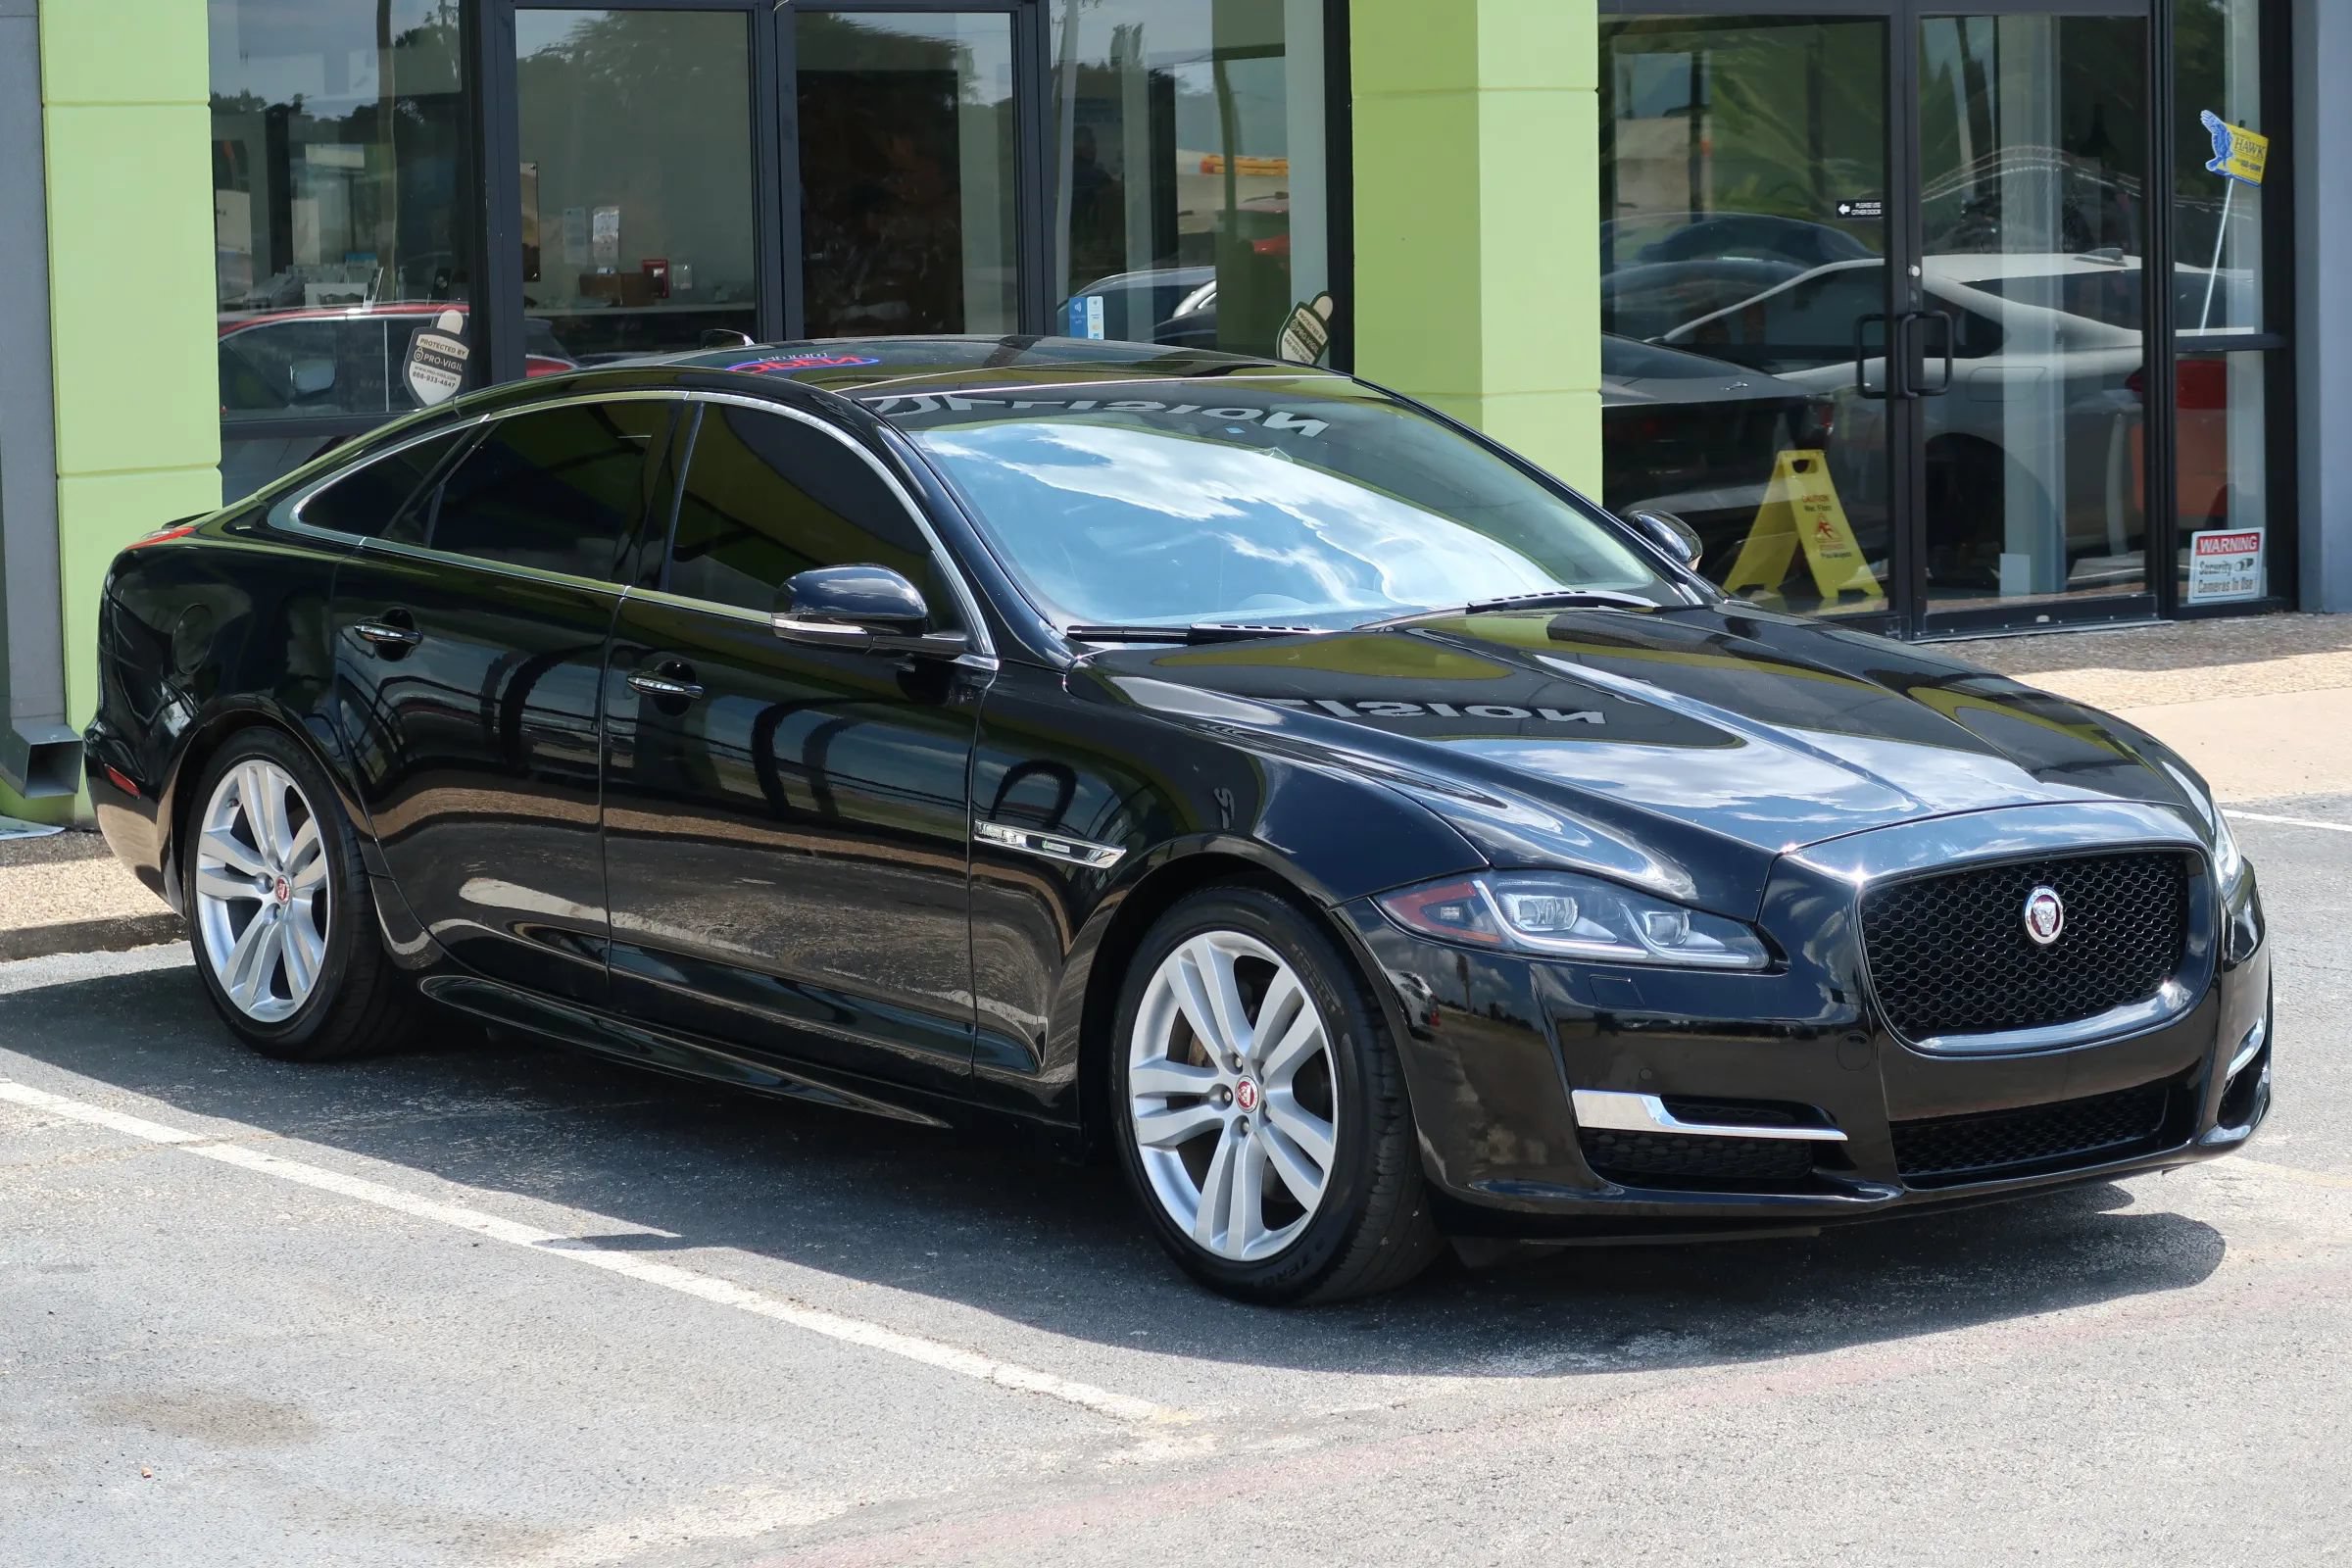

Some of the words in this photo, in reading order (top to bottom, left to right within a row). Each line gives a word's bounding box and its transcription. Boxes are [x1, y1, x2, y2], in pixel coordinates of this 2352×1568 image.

[2234, 137, 2265, 158] HAWK
[419, 337, 456, 354] PROTECTED
[2199, 535, 2258, 554] WARNING
[2199, 560, 2232, 576] Security
[2198, 579, 2230, 594] Cameras
[2231, 577, 2239, 590] In
[2240, 576, 2254, 590] Use
